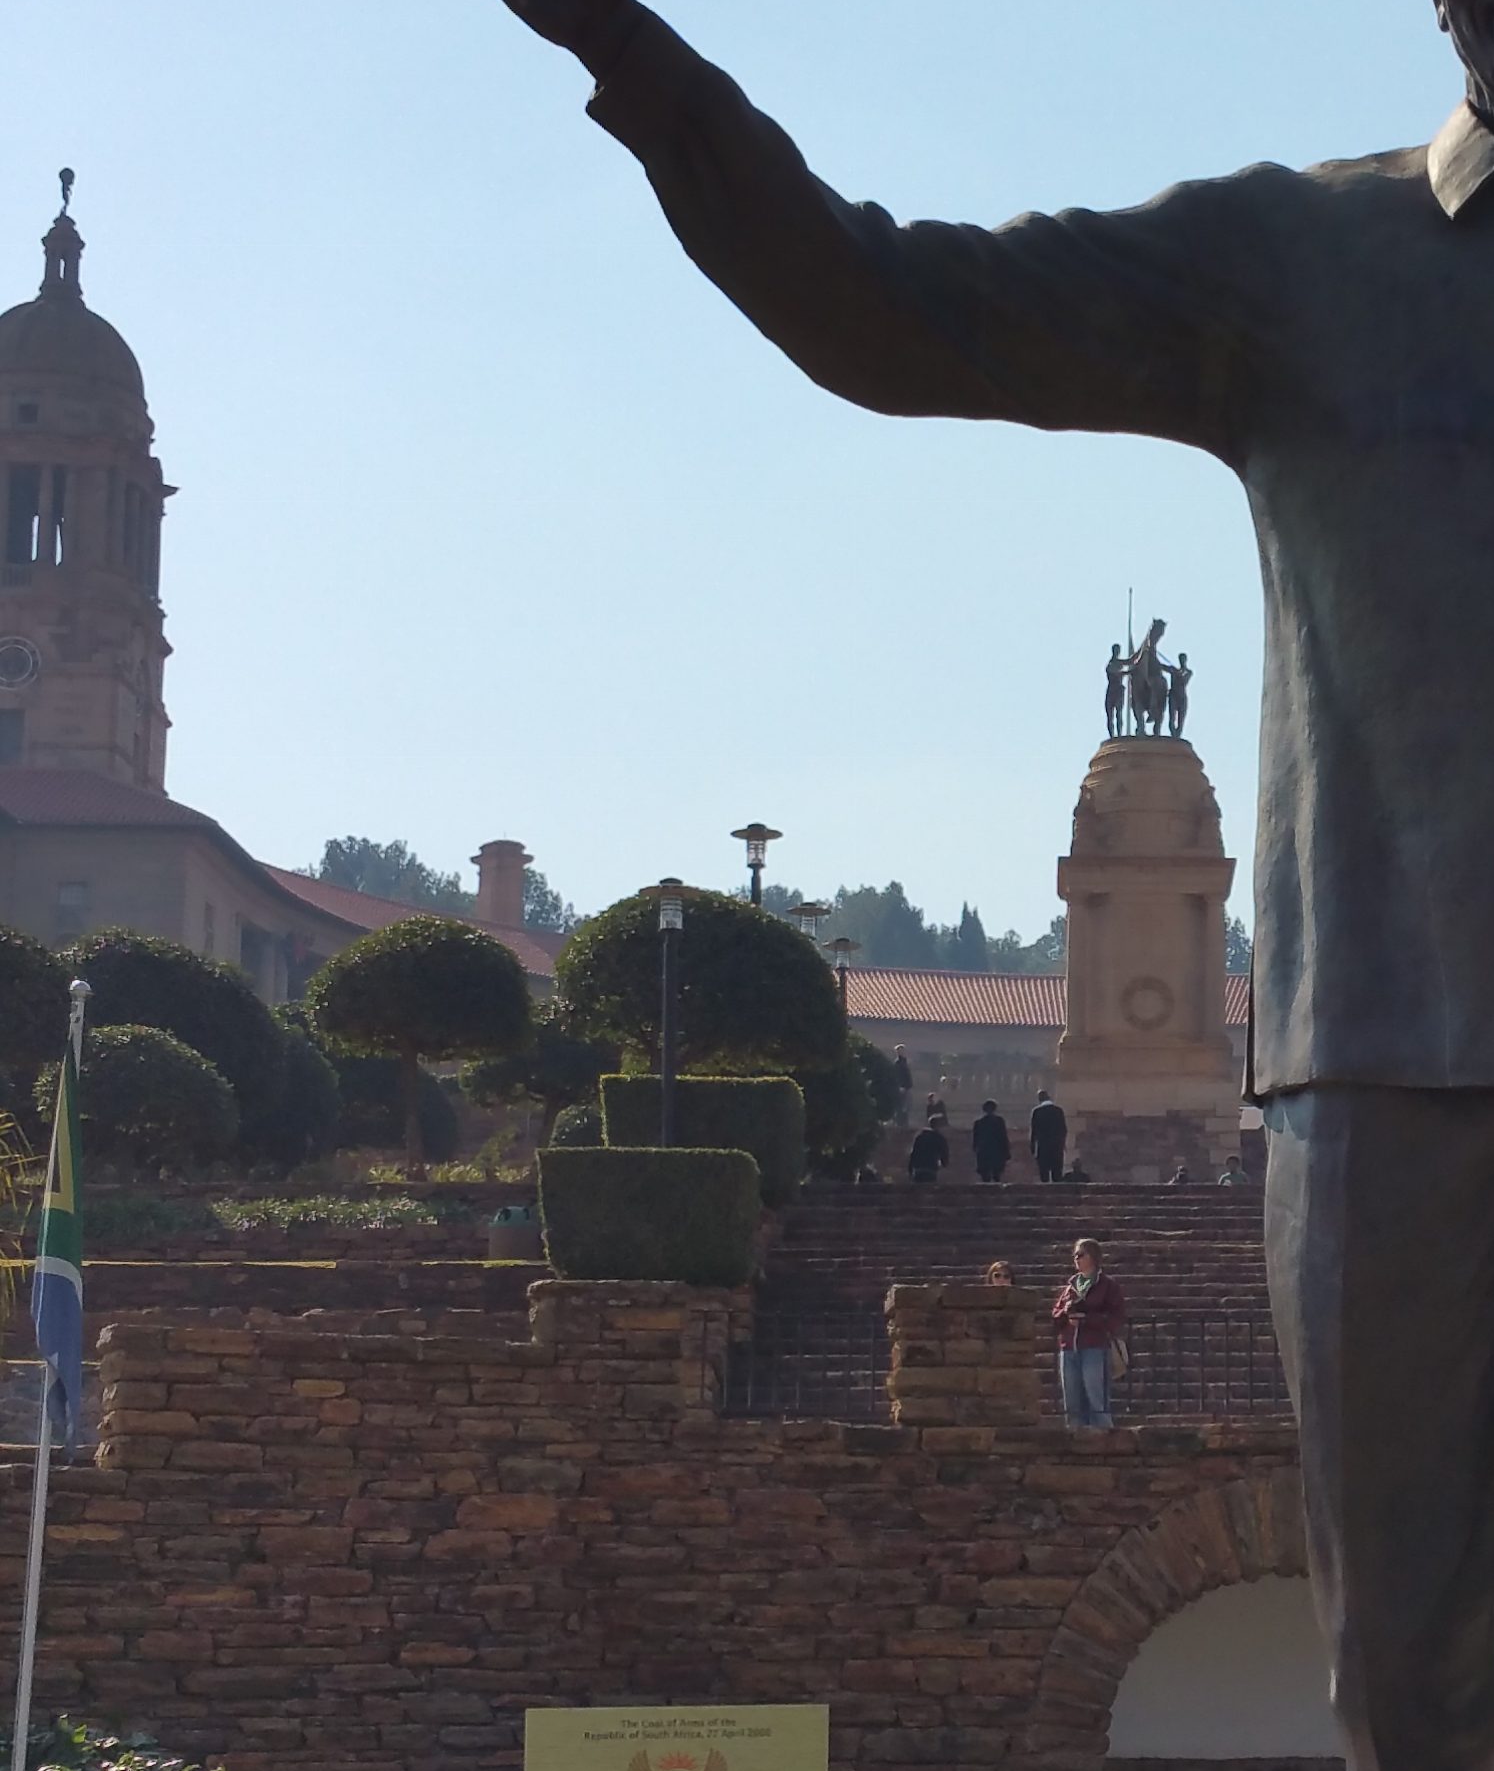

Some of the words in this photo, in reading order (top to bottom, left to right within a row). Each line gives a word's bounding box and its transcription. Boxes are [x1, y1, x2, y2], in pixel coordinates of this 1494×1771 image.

[622, 1719, 637, 1728] The
[667, 1718, 677, 1727] of
[708, 1717, 718, 1726] of
[721, 1718, 736, 1727] the
[584, 1731, 625, 1742] Republic
[629, 1730, 639, 1739] of
[642, 1730, 669, 1739] South
[721, 1728, 745, 1739] April
